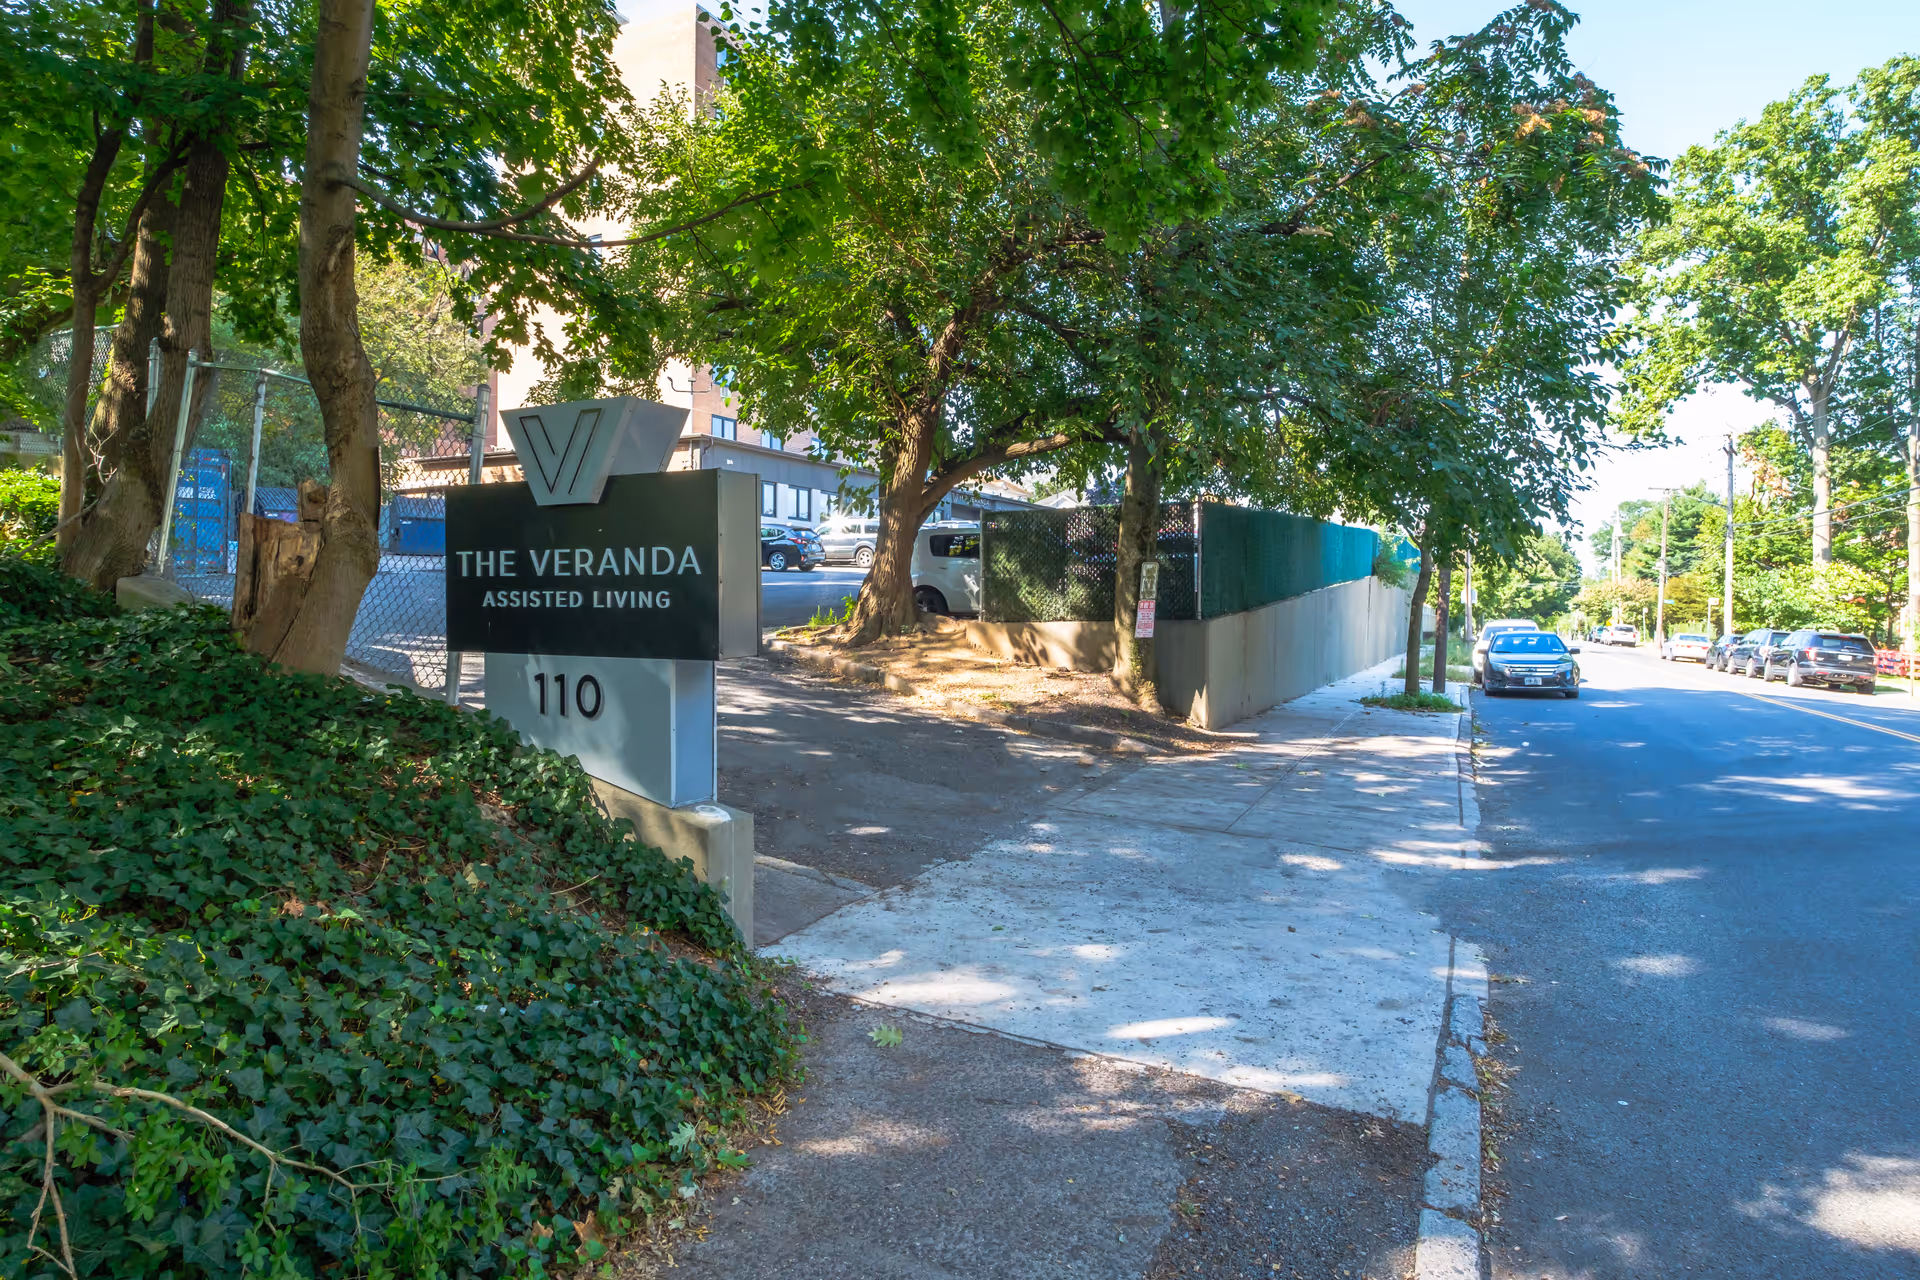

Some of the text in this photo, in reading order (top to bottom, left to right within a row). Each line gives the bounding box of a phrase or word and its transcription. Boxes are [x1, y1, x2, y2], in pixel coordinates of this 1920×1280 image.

[456, 546, 702, 577] THE VERANDA
[482, 591, 671, 609] ASSISTED LIVING
[534, 673, 602, 719] 110
